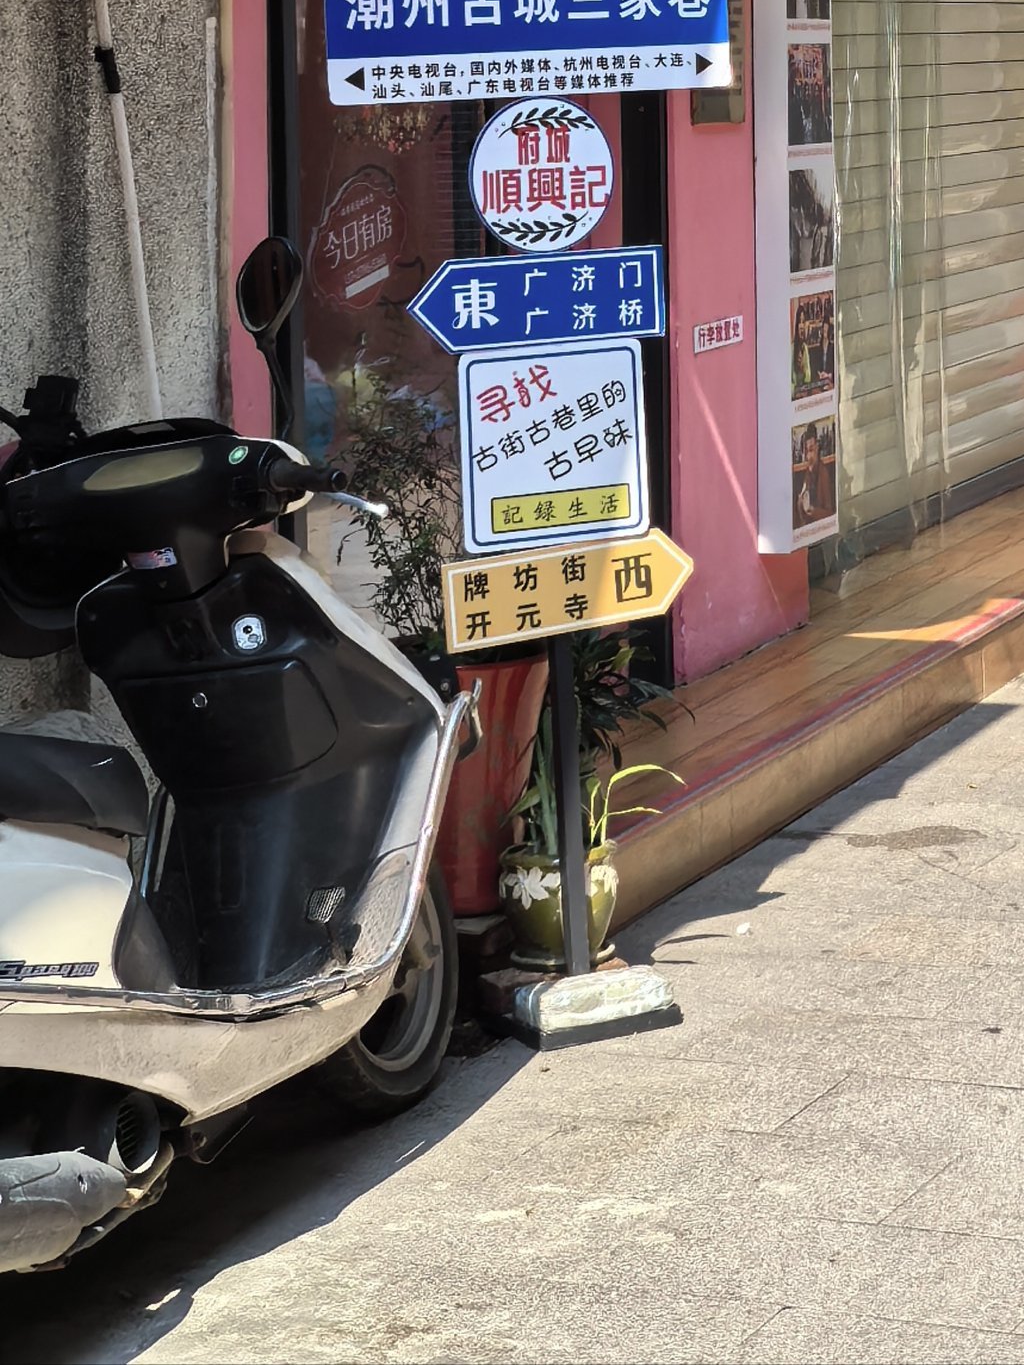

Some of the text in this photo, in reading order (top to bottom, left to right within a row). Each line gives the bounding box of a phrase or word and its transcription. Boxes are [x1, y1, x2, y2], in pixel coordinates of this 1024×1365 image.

[372, 72, 635, 100] 汕头、汕尾、广东电视台等媒体推荐
[516, 125, 571, 165] 府城
[481, 165, 609, 214] 順興記
[323, 205, 393, 269] 今日有房
[523, 260, 643, 297] 广济门
[450, 278, 500, 330] 東
[525, 298, 644, 336] 广济桥
[476, 364, 558, 424] 寻找
[472, 380, 627, 473] 古街古巷里的
[543, 418, 634, 482] 古早味
[463, 555, 586, 603] 牌坊街
[611, 552, 653, 604] 西
[466, 593, 589, 641] 开元寺
